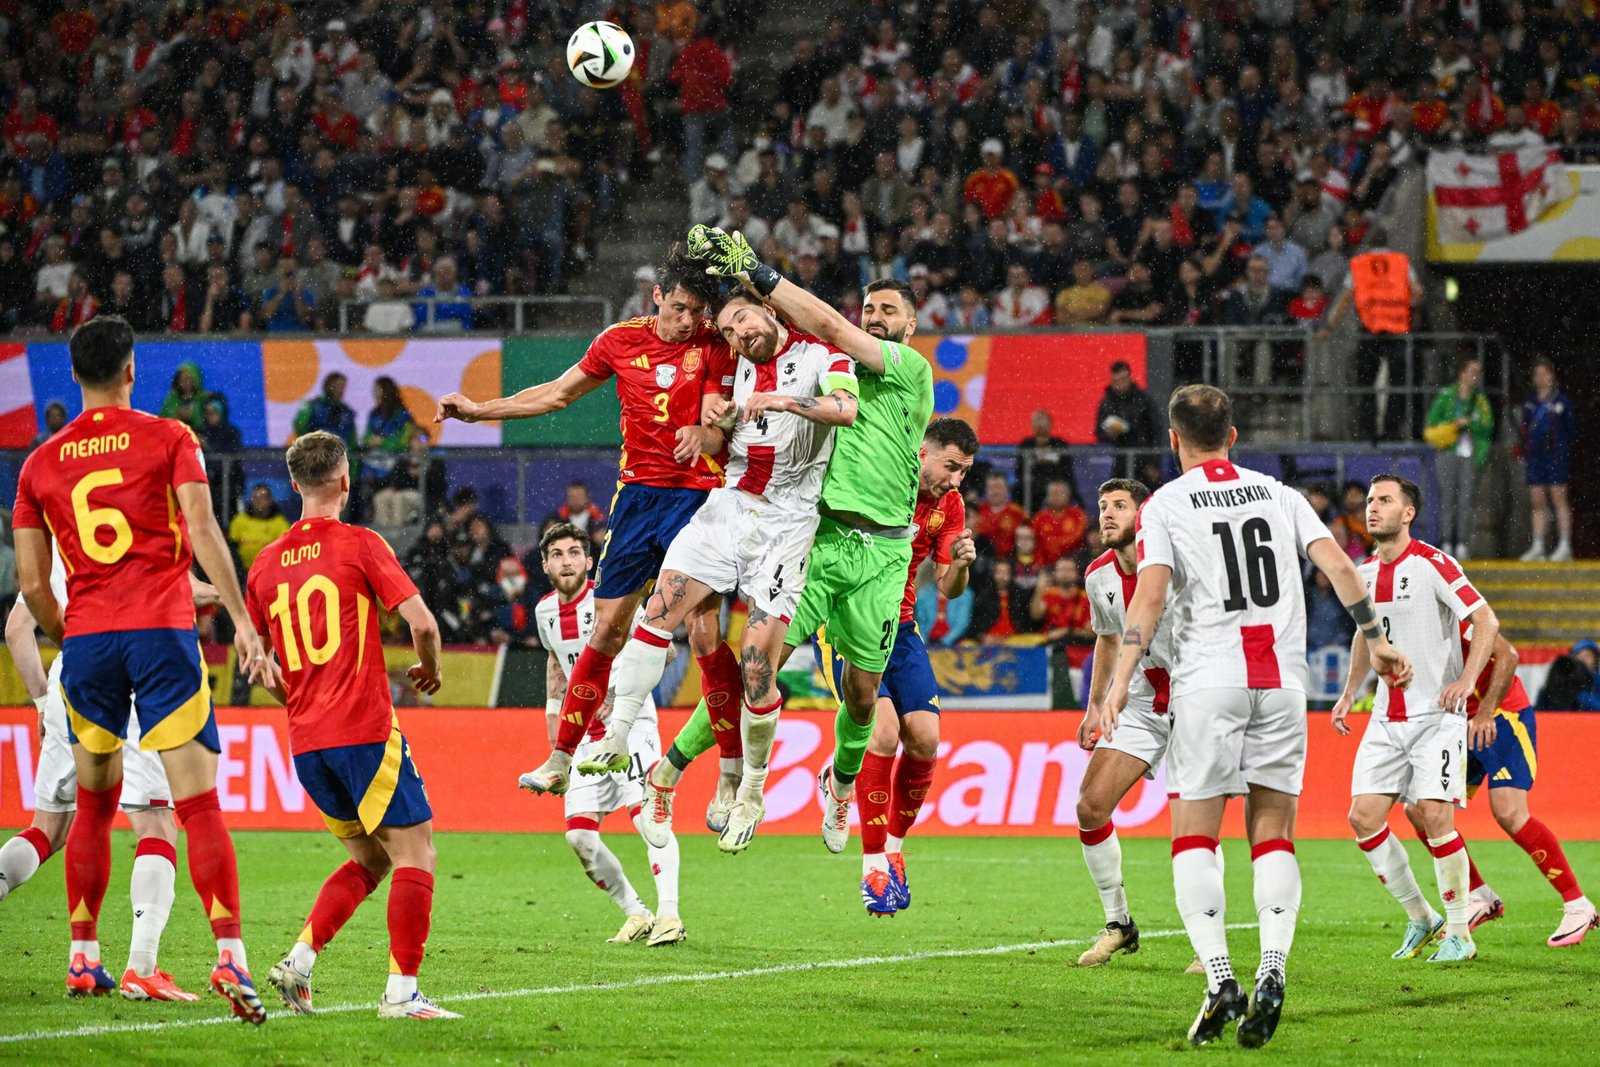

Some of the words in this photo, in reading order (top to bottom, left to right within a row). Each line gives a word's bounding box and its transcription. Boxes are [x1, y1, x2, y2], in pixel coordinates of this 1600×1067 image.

[653, 392, 670, 423] 3
[756, 415, 769, 436] 4
[59, 432, 130, 462] MERINO
[1189, 485, 1273, 509] KVEKVESKIRI
[70, 468, 134, 565] 6
[280, 542, 321, 568] OLMO
[1212, 517, 1280, 613] 16
[269, 573, 342, 672] 10
[1382, 616, 1394, 645] 2
[1441, 749, 1450, 778] 2
